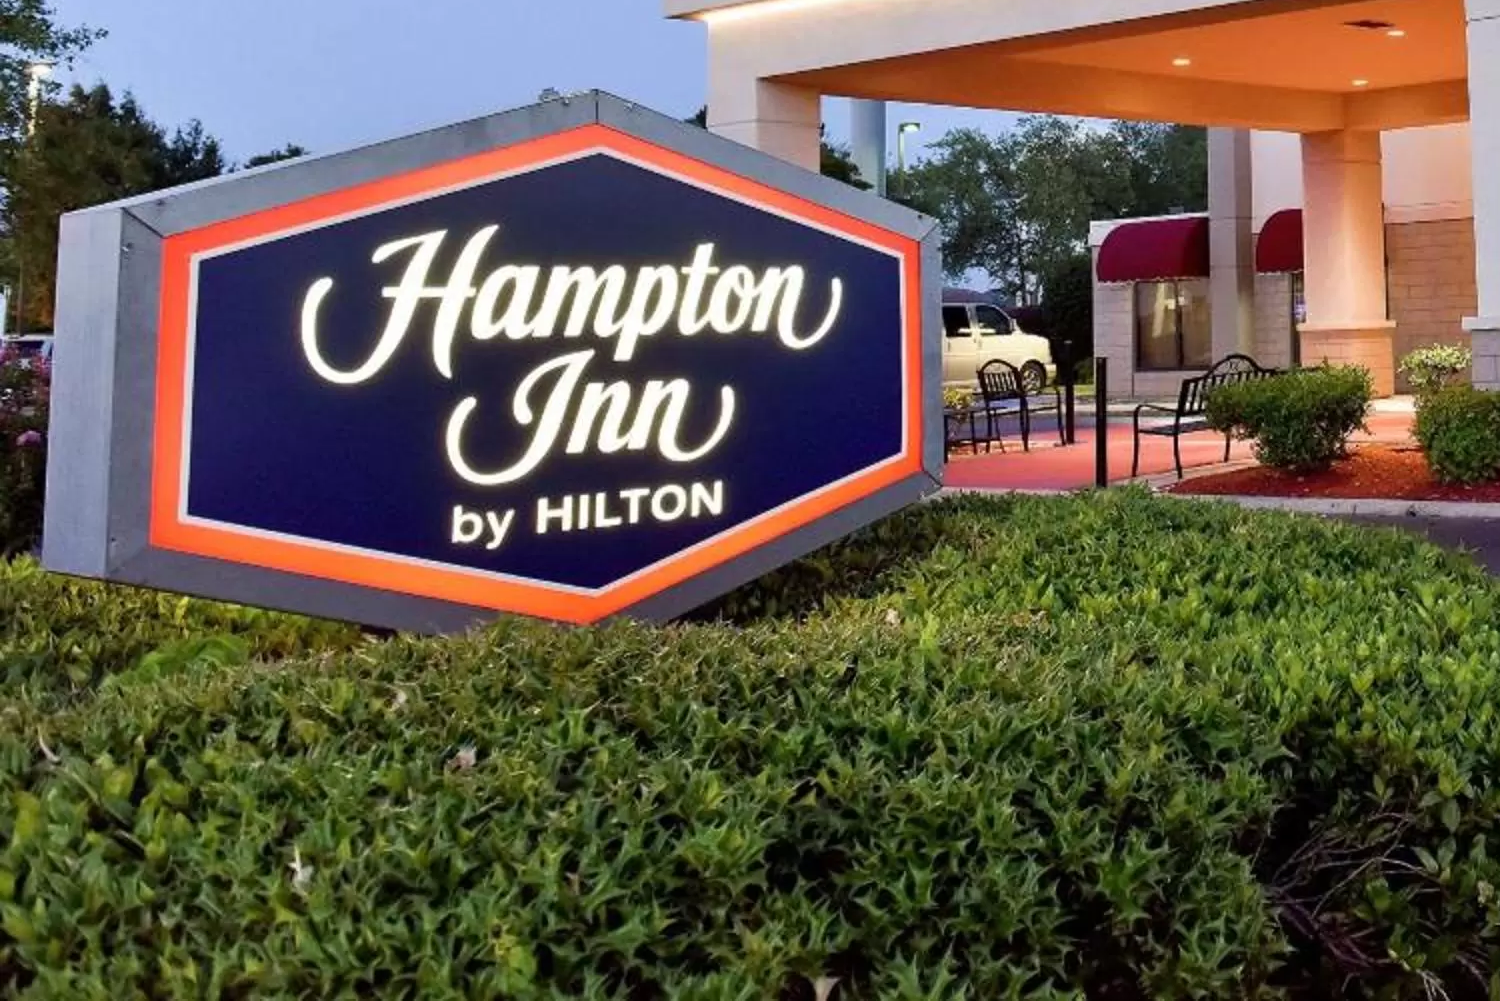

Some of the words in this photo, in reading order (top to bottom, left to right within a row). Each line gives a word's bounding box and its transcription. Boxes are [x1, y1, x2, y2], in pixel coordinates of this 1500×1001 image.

[301, 224, 843, 384] Hampton
[445, 349, 735, 486] Inn
[451, 505, 515, 550] by
[536, 480, 723, 534] HILTON
